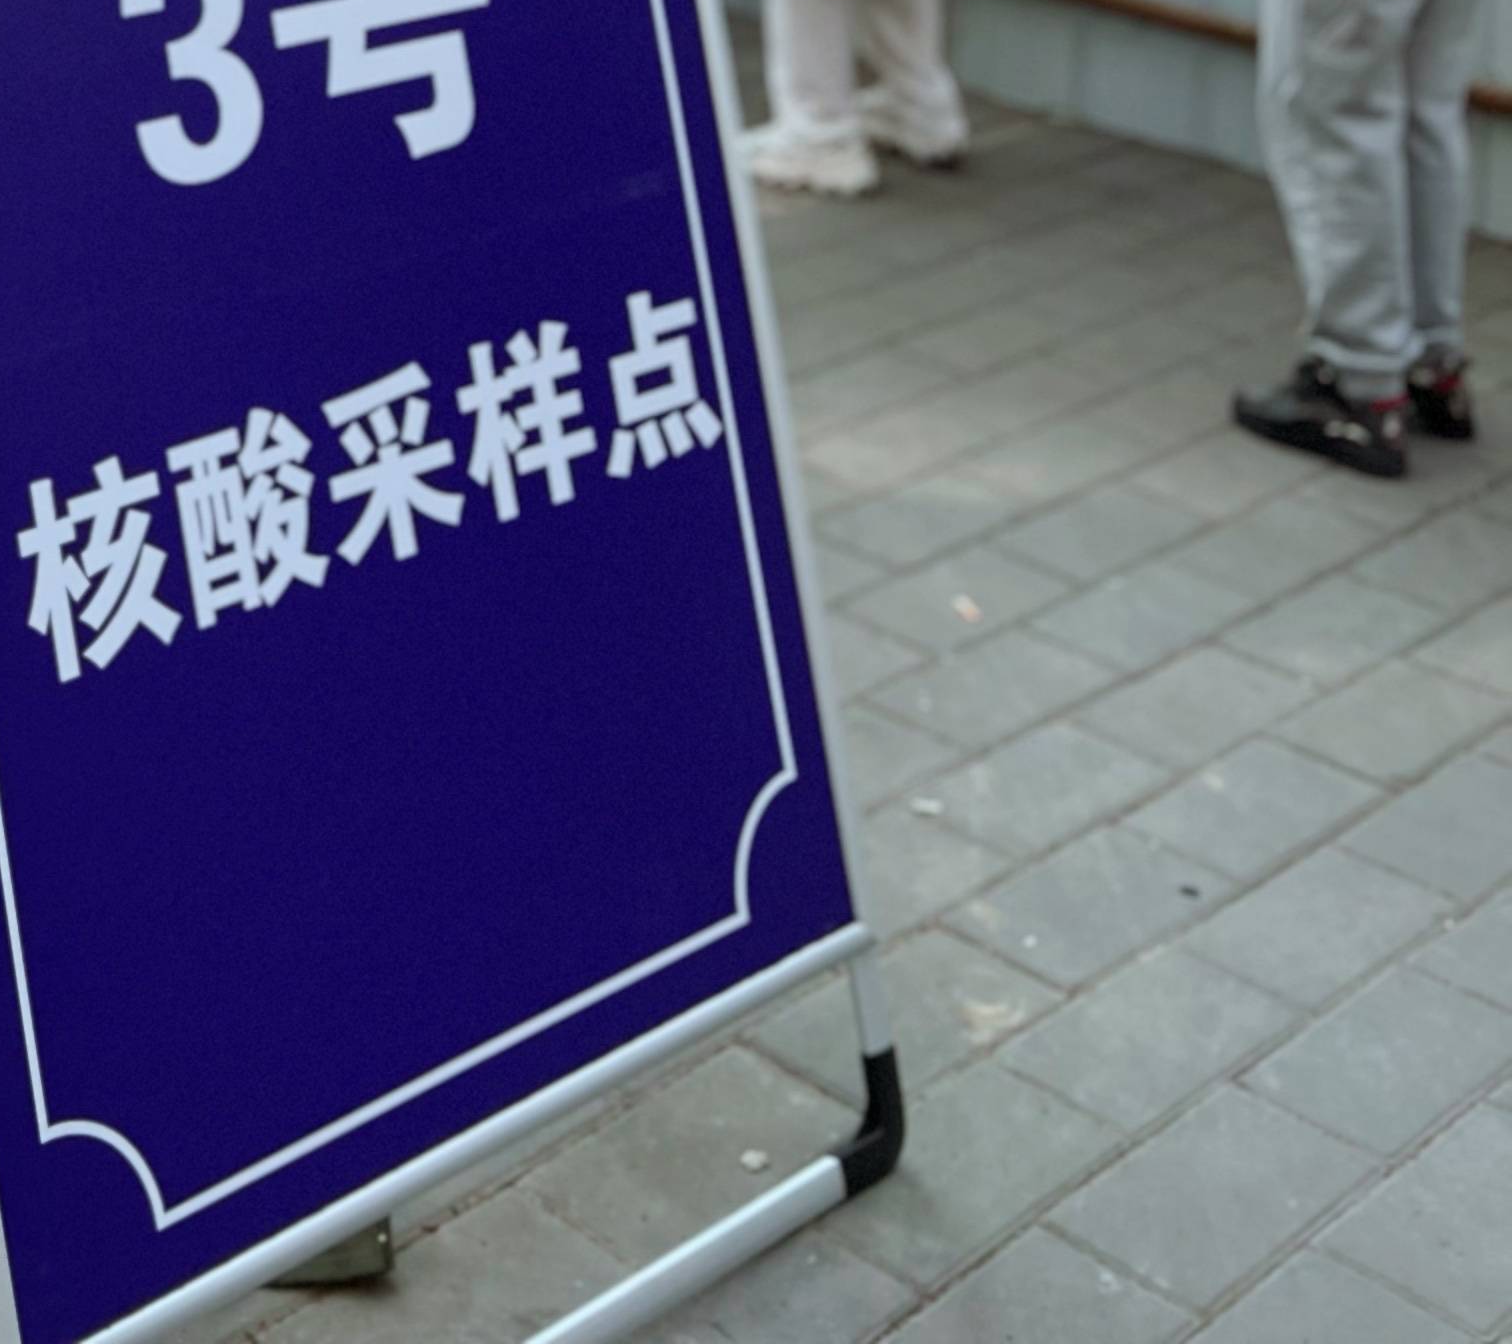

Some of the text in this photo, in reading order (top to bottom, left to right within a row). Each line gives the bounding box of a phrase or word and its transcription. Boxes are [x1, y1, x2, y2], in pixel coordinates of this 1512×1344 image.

[16, 290, 725, 685] 核酸采样点
